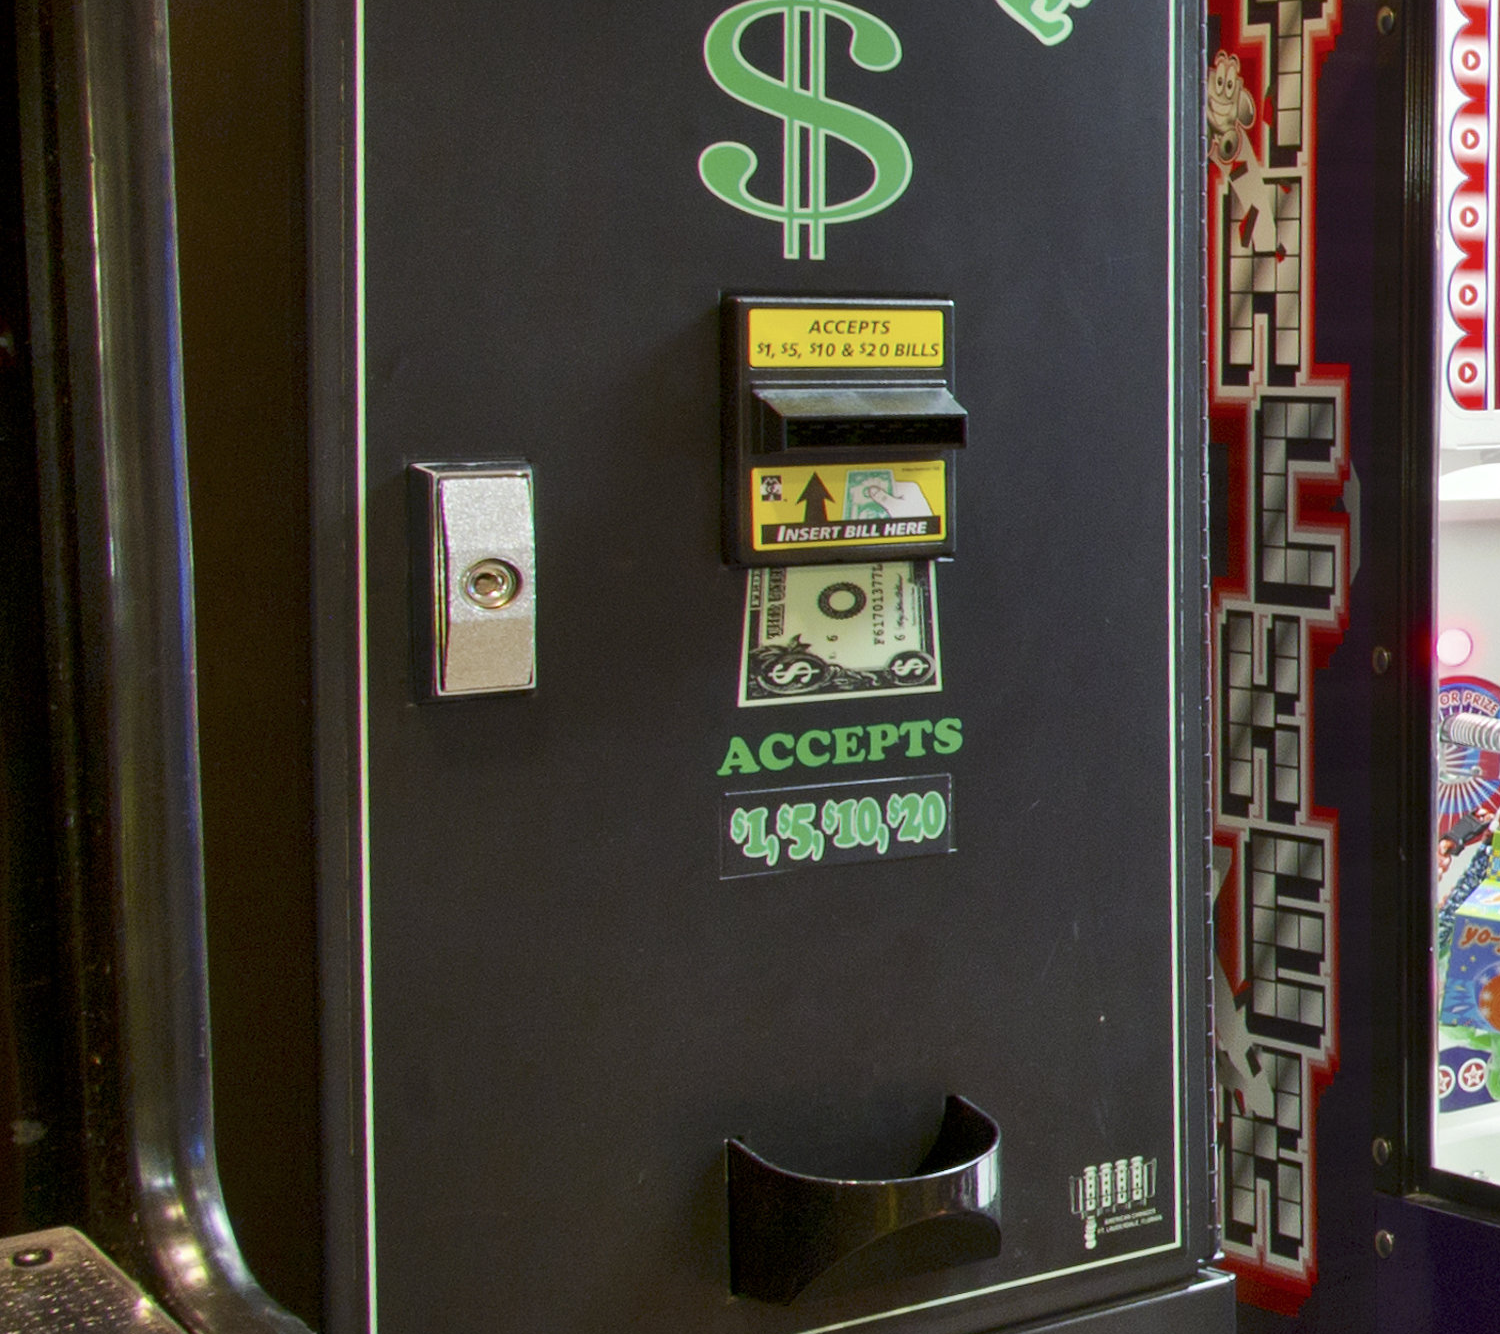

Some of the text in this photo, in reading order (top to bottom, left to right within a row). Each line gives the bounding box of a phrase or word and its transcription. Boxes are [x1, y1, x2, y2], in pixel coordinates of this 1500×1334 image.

[808, 320, 891, 334] ACCEPTS
[809, 342, 836, 357] $10
[842, 344, 854, 357] &
[894, 343, 940, 357] BILLS
[776, 521, 928, 542] INSERT BILL HERE
[1463, 692, 1500, 716] PRIZE
[716, 717, 964, 776] ACCEPTS
